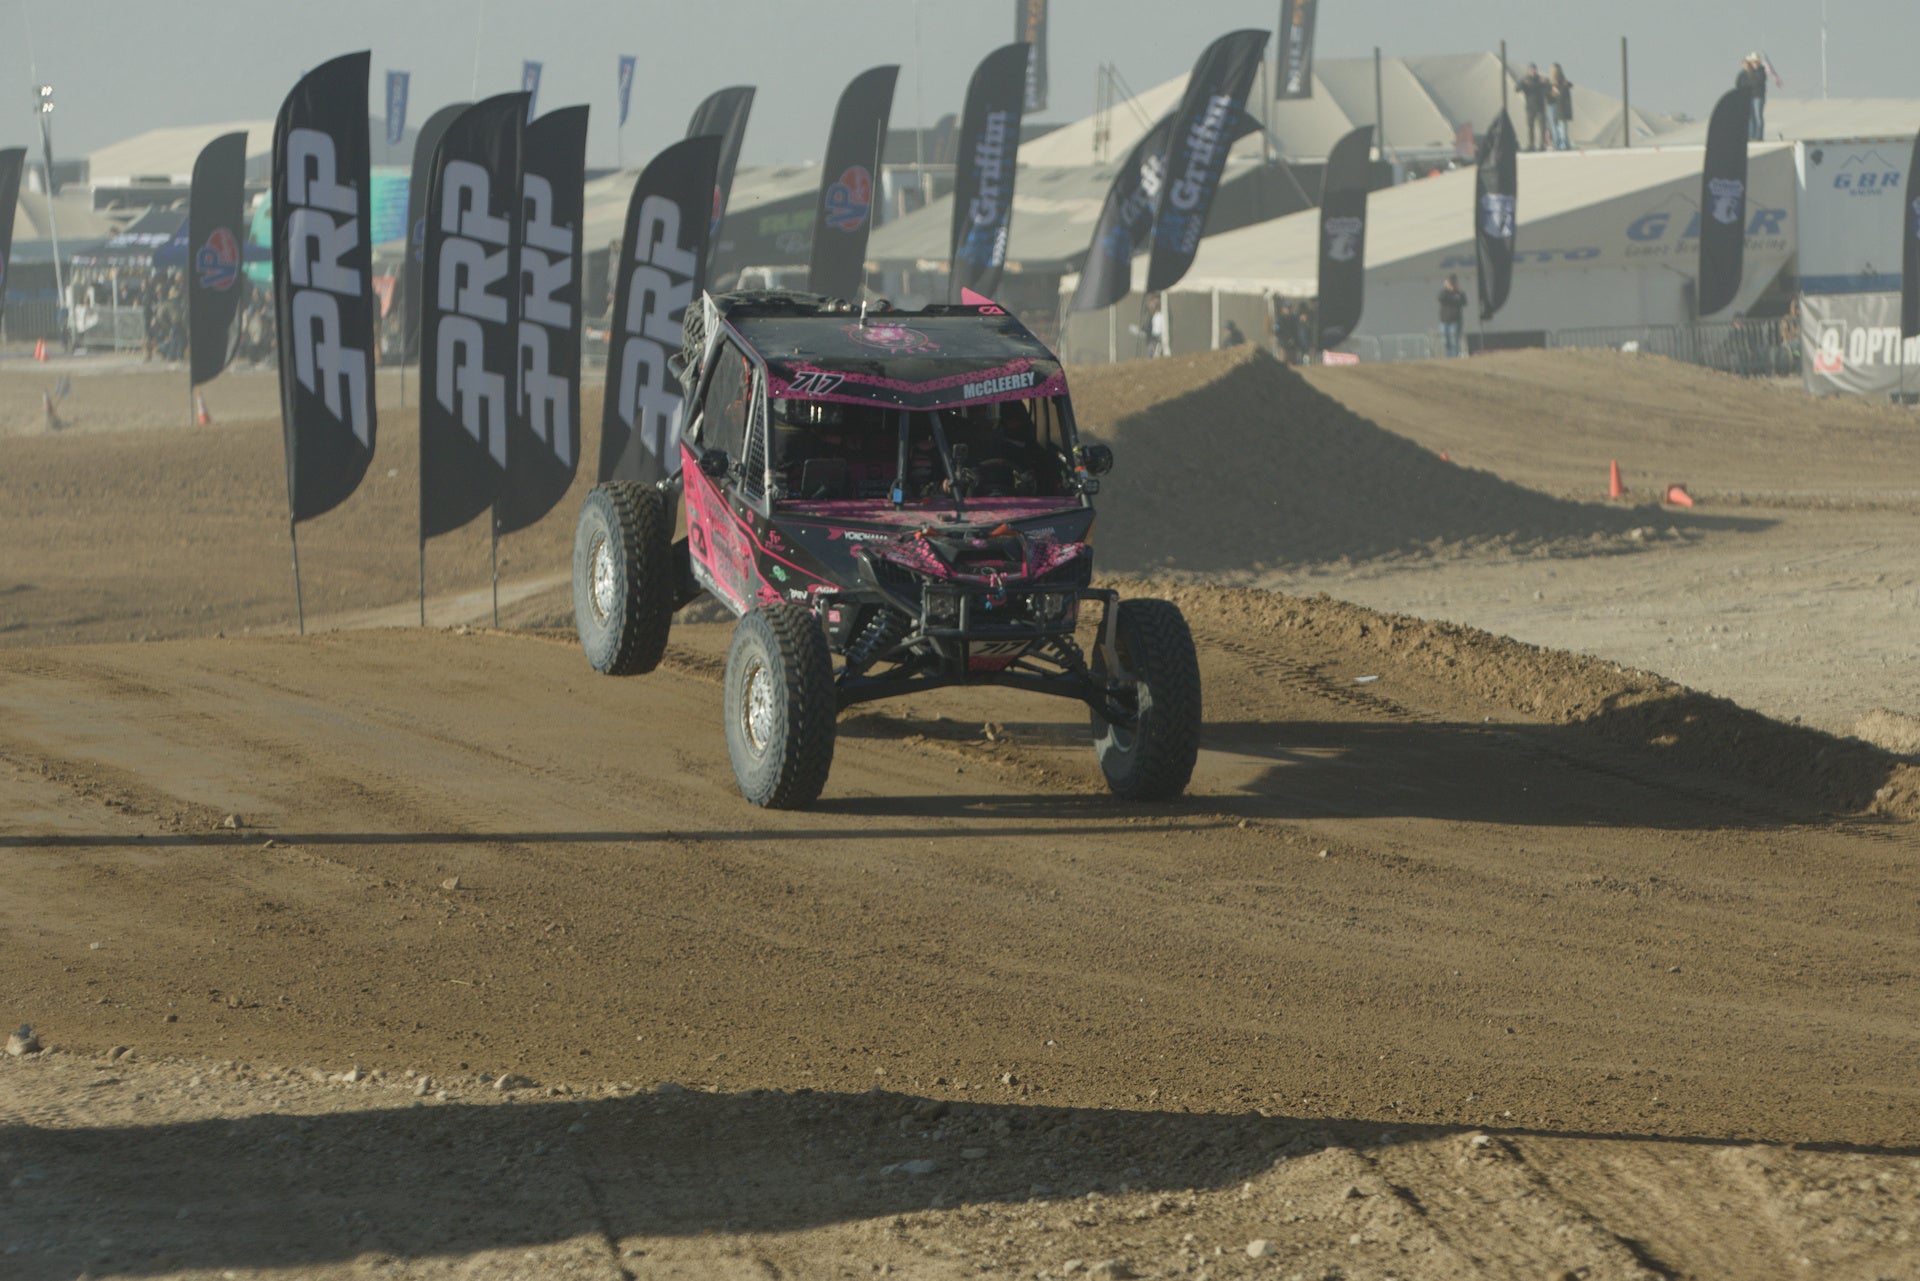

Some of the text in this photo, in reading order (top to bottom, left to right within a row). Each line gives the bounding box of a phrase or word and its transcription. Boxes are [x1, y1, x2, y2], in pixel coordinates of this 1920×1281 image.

[968, 110, 1007, 226] Griffin
[1171, 95, 1231, 210] Griffin
[287, 127, 368, 449] PRP
[436, 159, 511, 470] PRP
[517, 172, 574, 469] PRP
[619, 194, 698, 476] PRP
[789, 372, 844, 395] 717
[963, 372, 1036, 399] McCLEEREY
